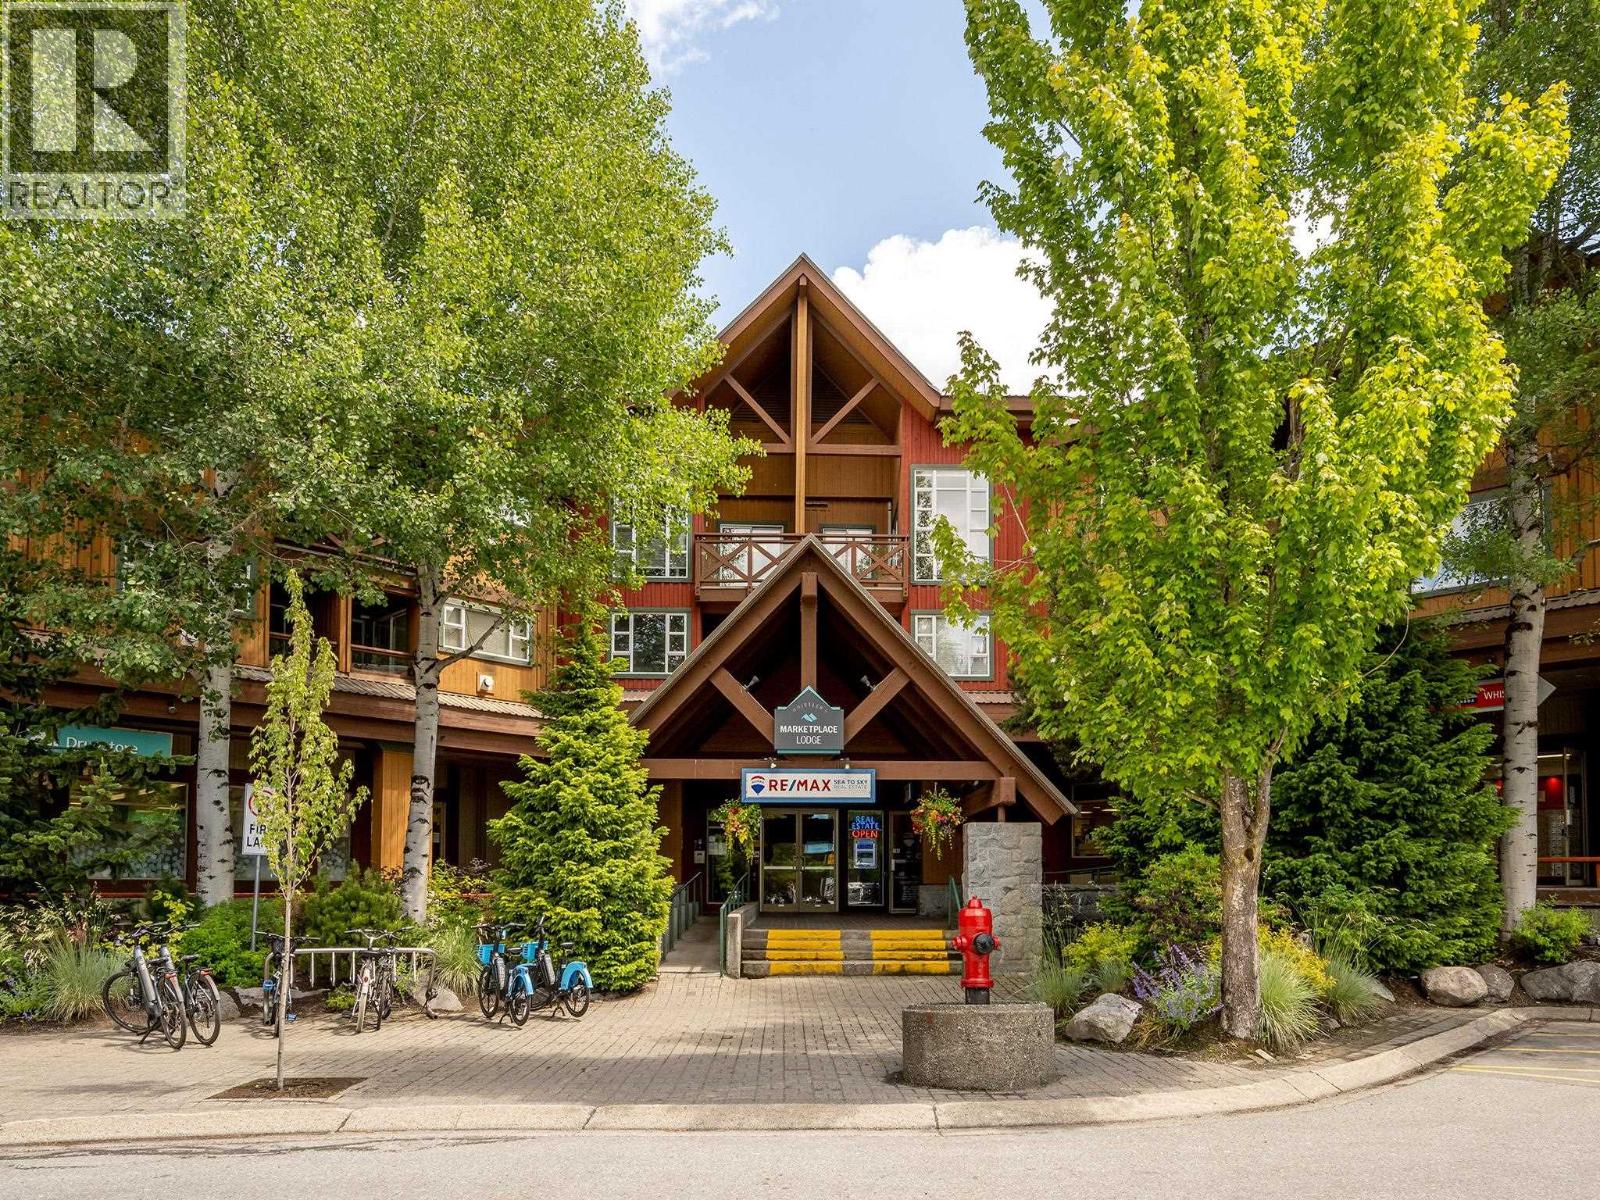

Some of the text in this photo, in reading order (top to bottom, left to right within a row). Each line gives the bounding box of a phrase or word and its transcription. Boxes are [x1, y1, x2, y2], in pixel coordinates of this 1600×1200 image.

[780, 725, 838, 734] MARKETPLACE
[796, 735, 822, 745] LODGE
[768, 779, 832, 792] RE/MAX
[855, 815, 874, 823] REAL
[249, 824, 267, 834] FIR
[851, 822, 879, 830] ESTATE
[851, 830, 878, 838] OPEN
